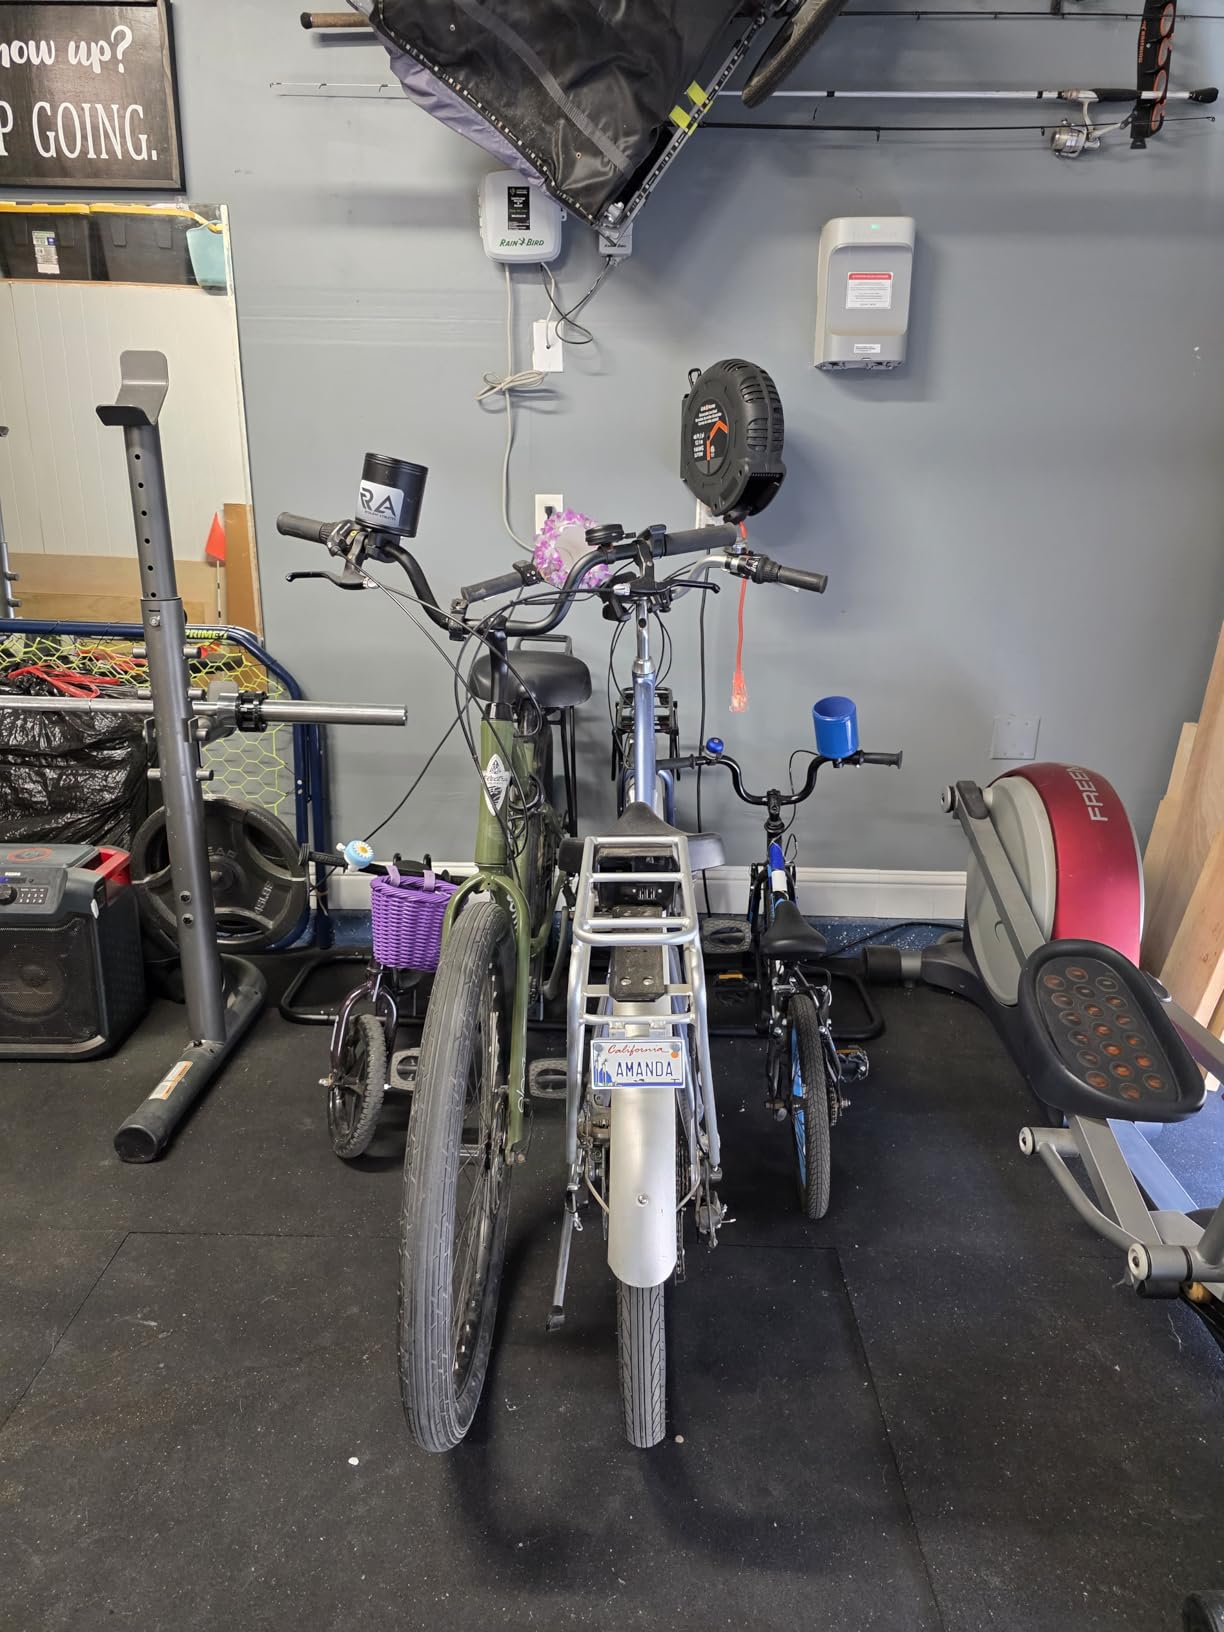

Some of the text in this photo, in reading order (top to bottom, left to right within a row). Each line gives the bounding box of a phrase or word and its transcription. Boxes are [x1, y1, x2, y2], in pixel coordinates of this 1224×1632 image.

[68, 25, 133, 74] up?
[32, 101, 158, 161] GOING.
[499, 238, 545, 247] RAIN BIRD
[360, 487, 397, 517] RA
[607, 1044, 670, 1056] California
[616, 1061, 673, 1077] AMANDA
